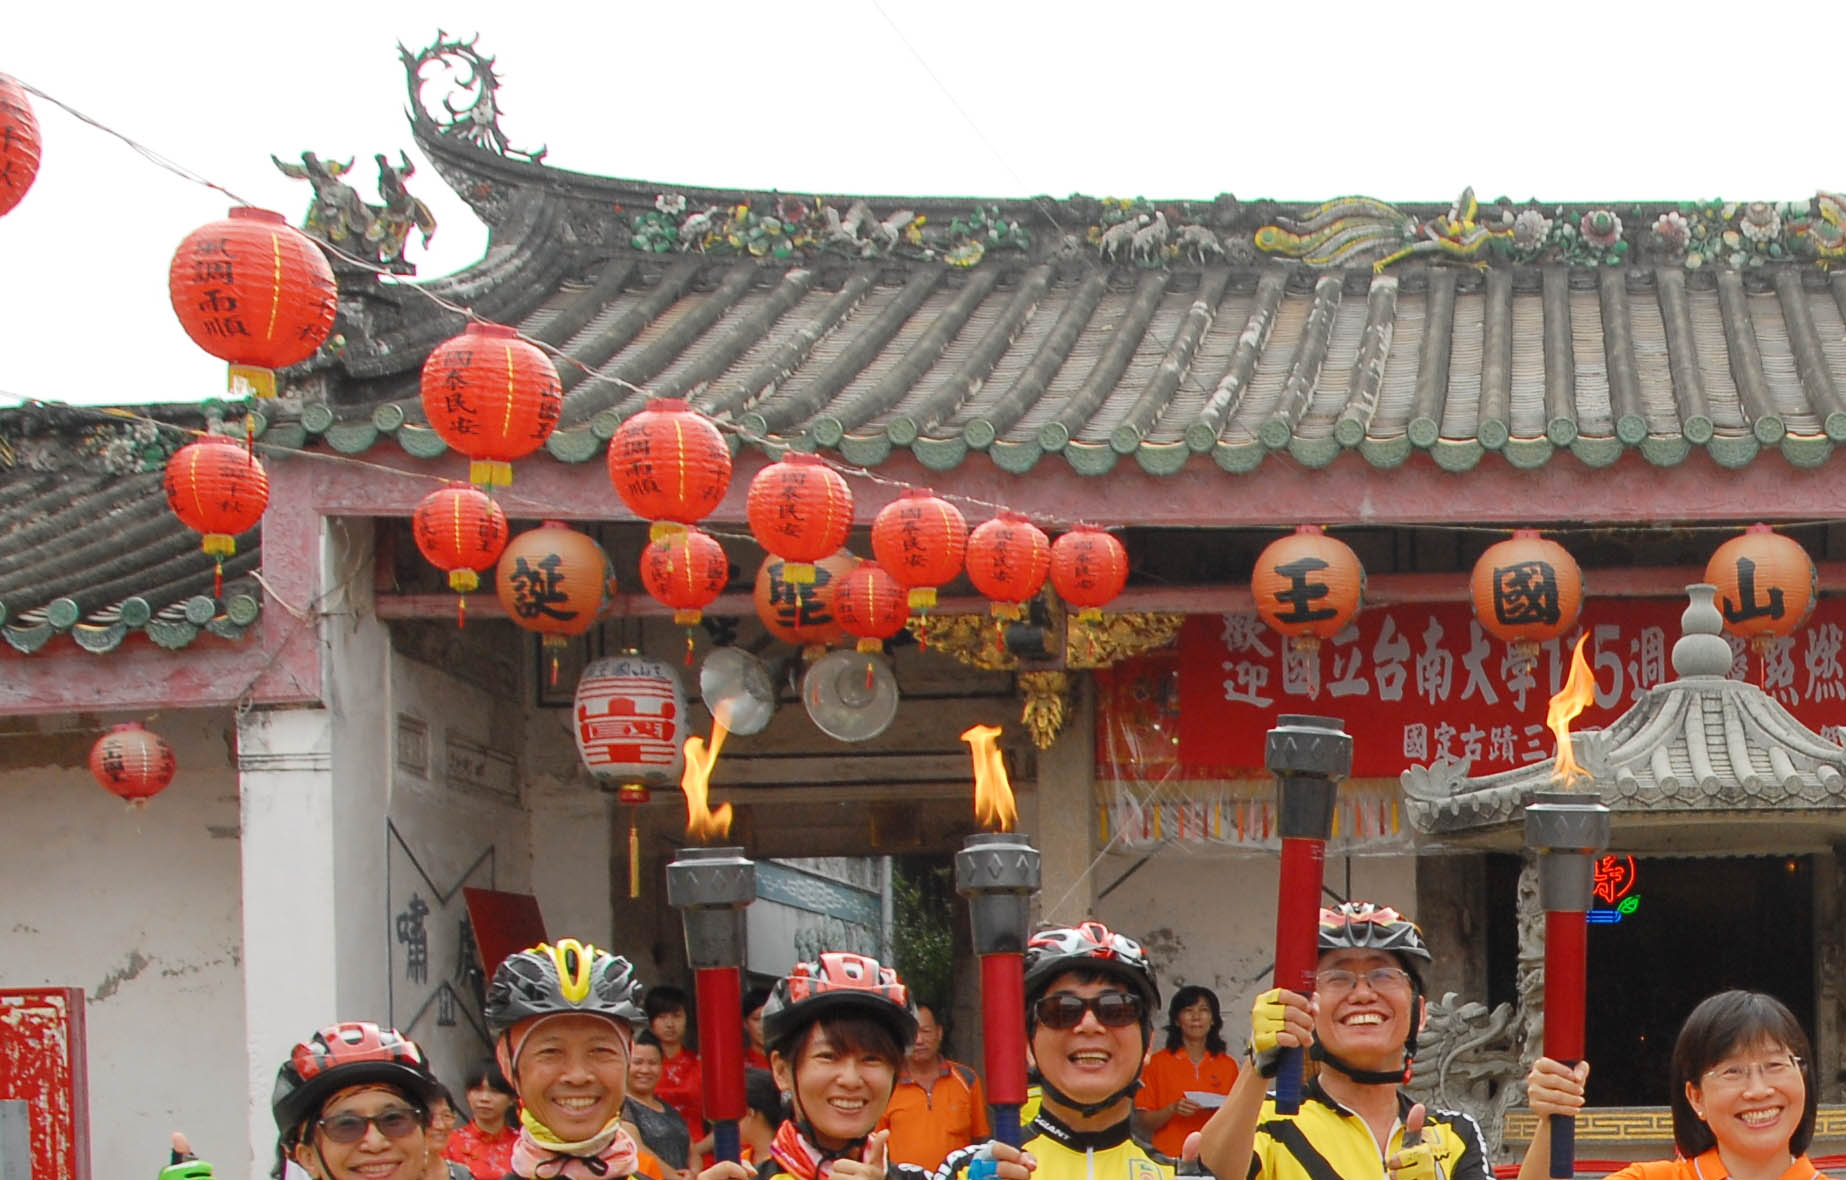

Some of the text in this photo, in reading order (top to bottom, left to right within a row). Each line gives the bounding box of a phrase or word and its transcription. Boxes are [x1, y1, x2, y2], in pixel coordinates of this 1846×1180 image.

[443, 350, 481, 435] 國泰民安
[509, 553, 581, 625] 誕
[768, 563, 833, 628] 聖
[1273, 556, 1339, 625] 王
[1493, 560, 1563, 626] 國
[1722, 556, 1786, 625] 山
[1221, 611, 1274, 708] 歡迎
